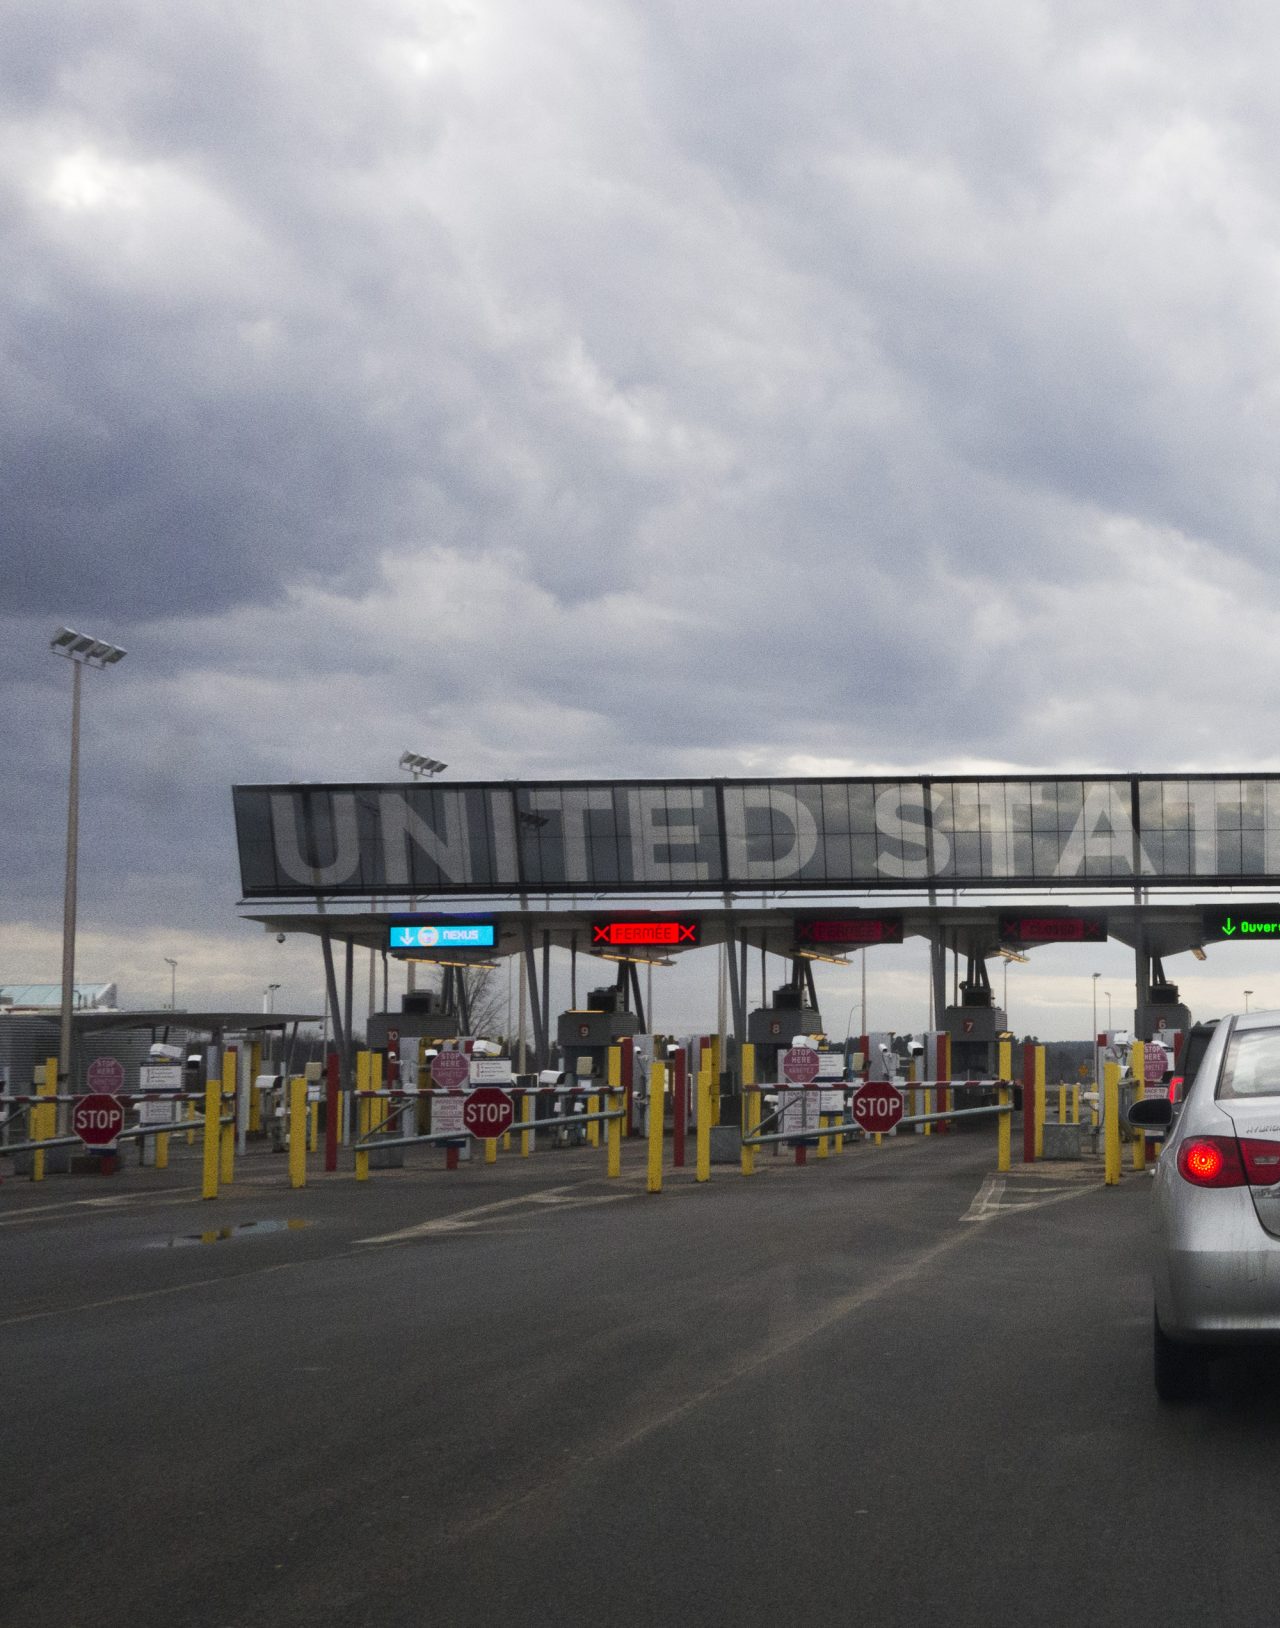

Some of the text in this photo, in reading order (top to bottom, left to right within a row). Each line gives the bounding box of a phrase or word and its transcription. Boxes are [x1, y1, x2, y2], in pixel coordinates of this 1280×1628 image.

[269, 784, 818, 885] UNITED
[443, 929, 479, 940] NEXUS
[772, 1023, 781, 1034] 8
[965, 1021, 975, 1033] 7
[1158, 1018, 1168, 1029] 6
[387, 1031, 399, 1041] 10
[580, 1026, 590, 1037] 9
[792, 1048, 811, 1056] STOP
[1144, 1045, 1161, 1053] STOP
[441, 1052, 461, 1060] STOP
[791, 1056, 811, 1064] HERE
[1144, 1053, 1162, 1061] HERE
[96, 1060, 115, 1068] STOP
[440, 1060, 461, 1068] HERE
[466, 1104, 510, 1122] STOP
[856, 1098, 900, 1117] STOP
[77, 1110, 121, 1129] STOP
